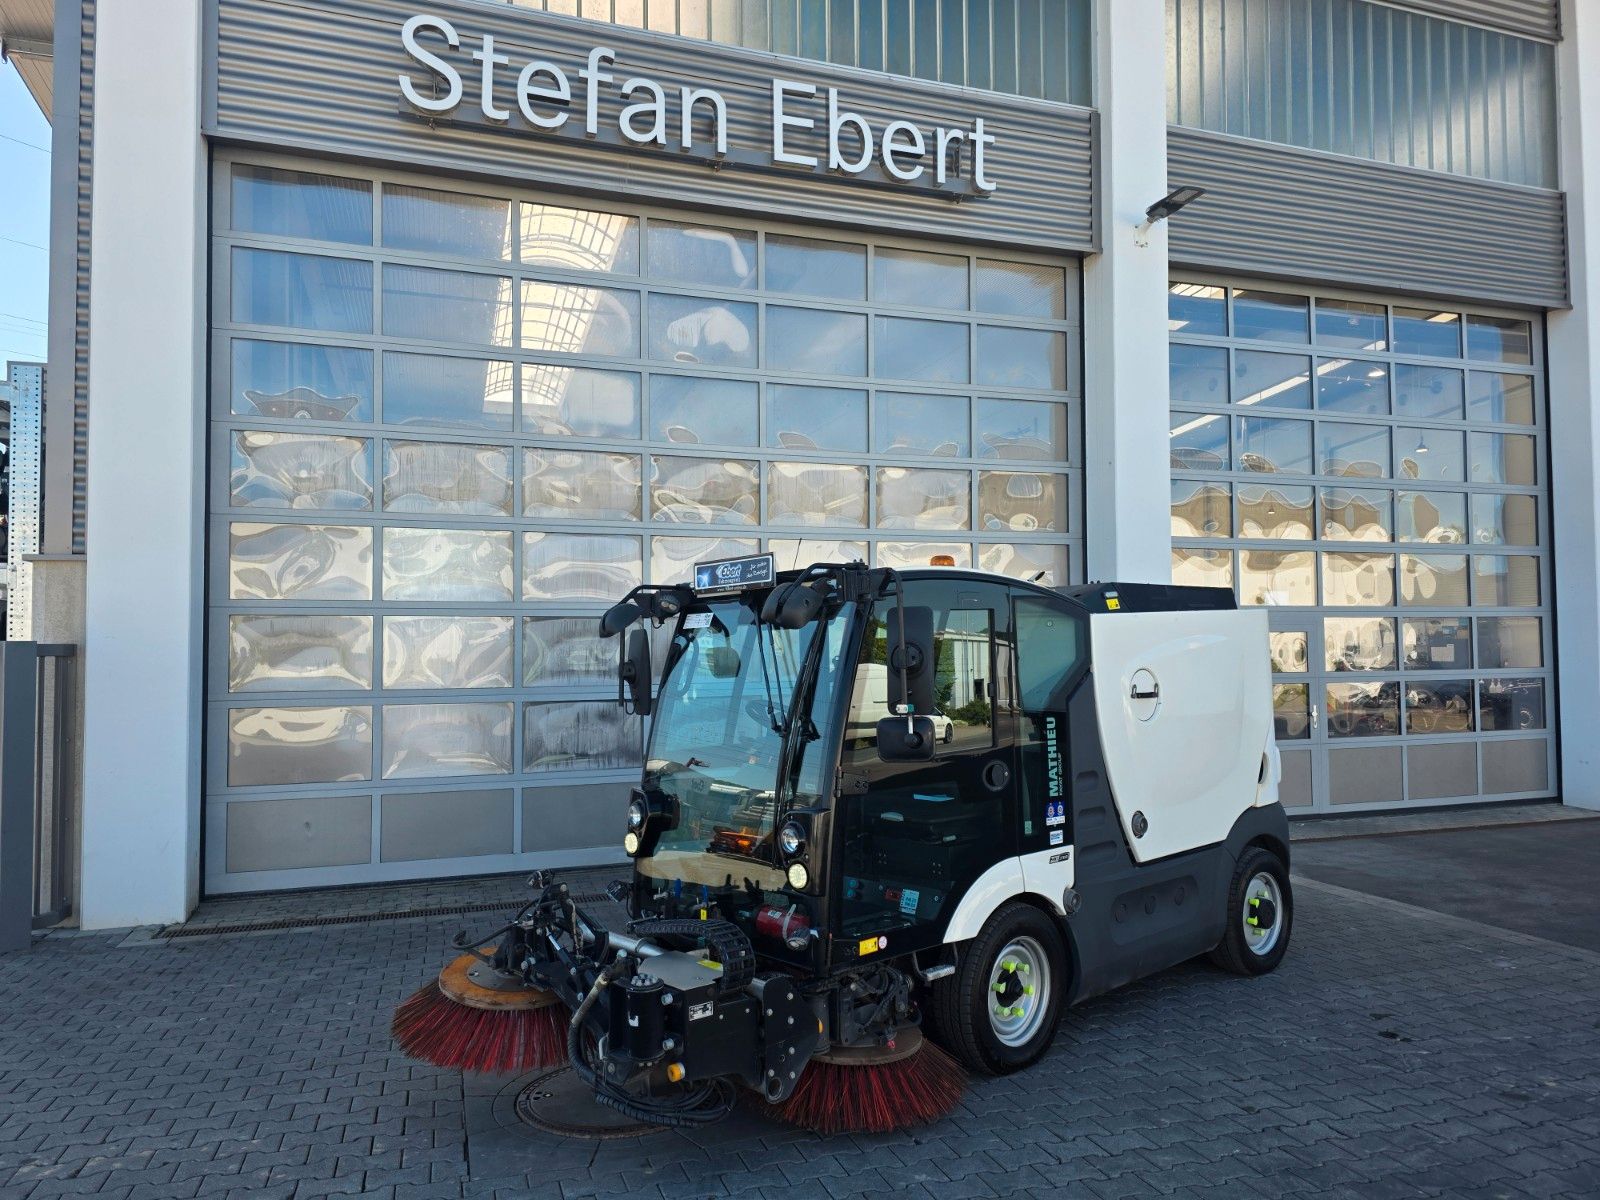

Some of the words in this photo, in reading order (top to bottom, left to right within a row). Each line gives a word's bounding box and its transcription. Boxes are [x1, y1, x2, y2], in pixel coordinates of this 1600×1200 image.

[399, 14, 727, 154] Stefan
[772, 78, 997, 193] Ebert
[1046, 716, 1059, 797] MATHIEU
